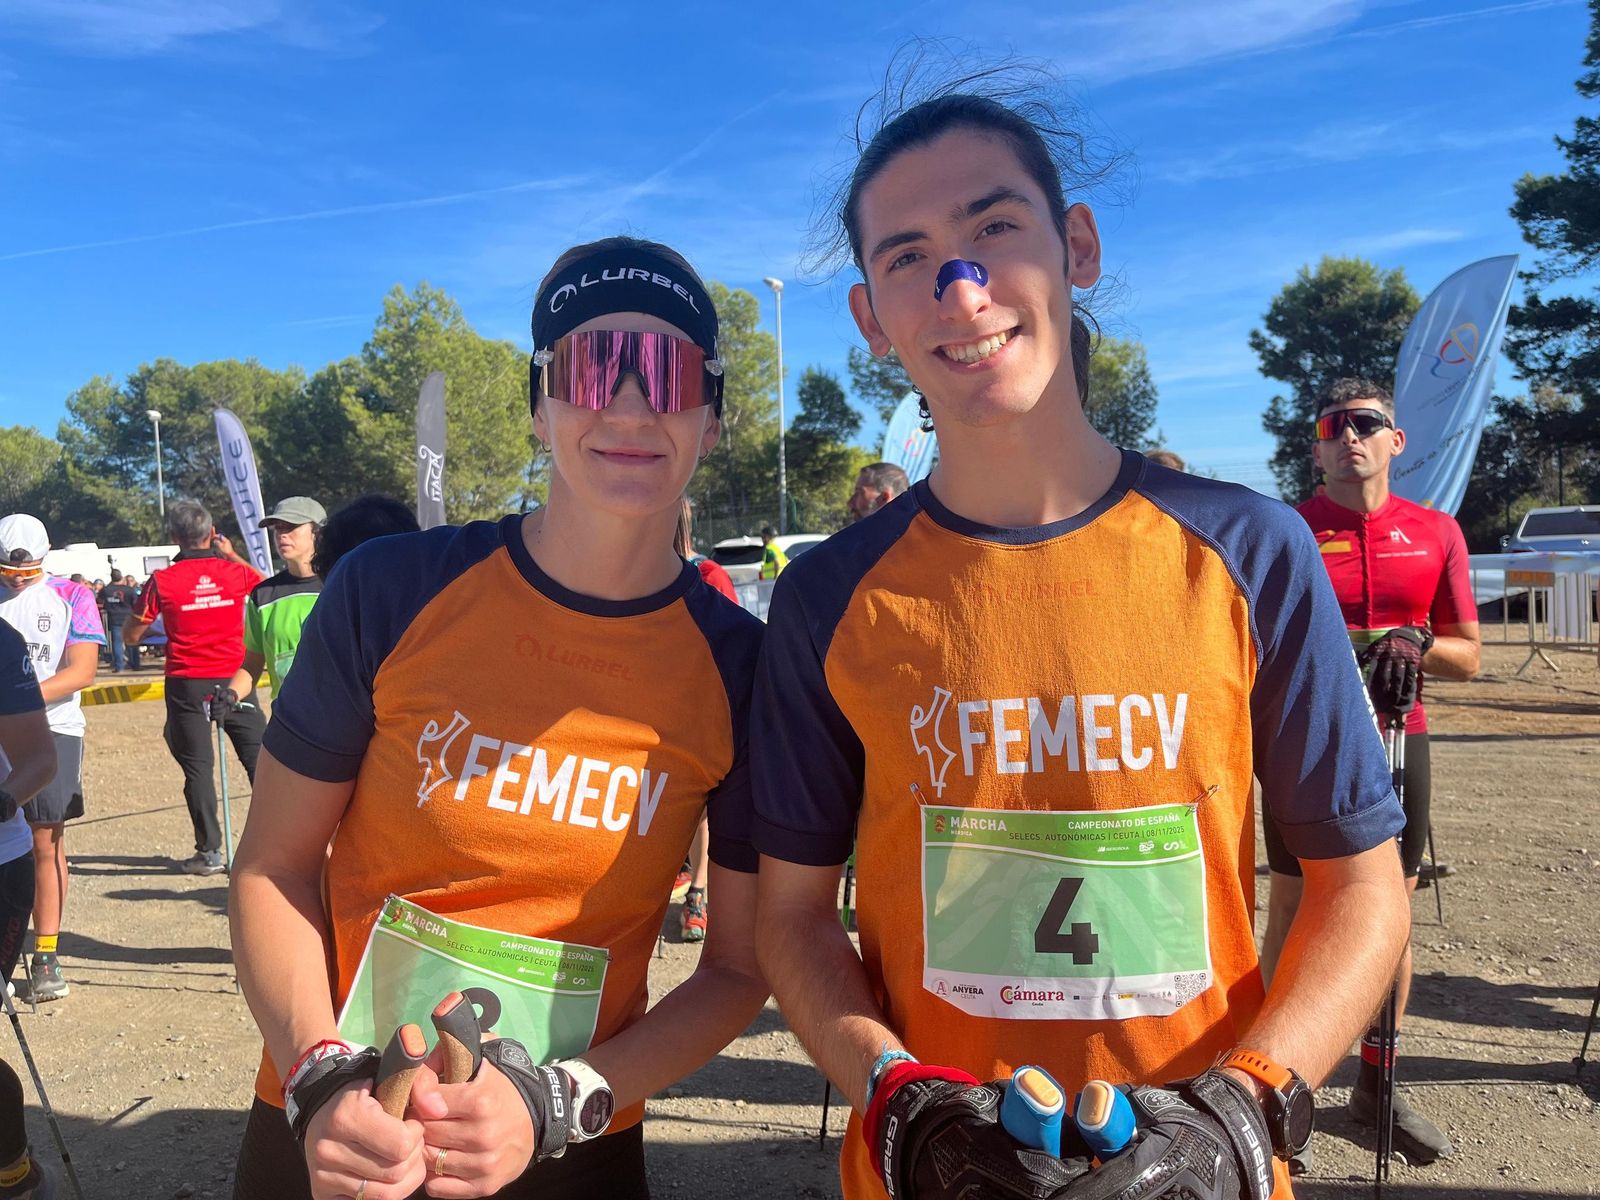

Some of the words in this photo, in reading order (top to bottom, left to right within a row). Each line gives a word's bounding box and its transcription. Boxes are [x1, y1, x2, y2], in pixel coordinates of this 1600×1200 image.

[580, 267, 701, 315] LURBEL
[957, 693, 1188, 776] FEMECV
[453, 733, 669, 836] FEMECV
[950, 816, 1008, 831] MARCHA
[1009, 832, 1043, 841] SELECS.
[1045, 831, 1106, 841] AUTONÓMICAS
[1113, 830, 1140, 840] CEUTA
[1146, 825, 1185, 838] 08/11/2025
[1068, 819, 1133, 830] CAMPEONATO
[1135, 818, 1146, 826] DE
[1148, 813, 1181, 825] ESPAÑA
[404, 911, 448, 938] MARCHA
[1034, 877, 1099, 965] 4
[446, 940, 476, 953] SELECS.
[477, 947, 529, 963] AUTONÓMICAS
[534, 958, 557, 968] CEUTA
[500, 940, 554, 957] CAMPEONATO
[555, 950, 566, 958] DE
[952, 985, 985, 995] ANYERA
[1000, 985, 1065, 1005] Cámara
